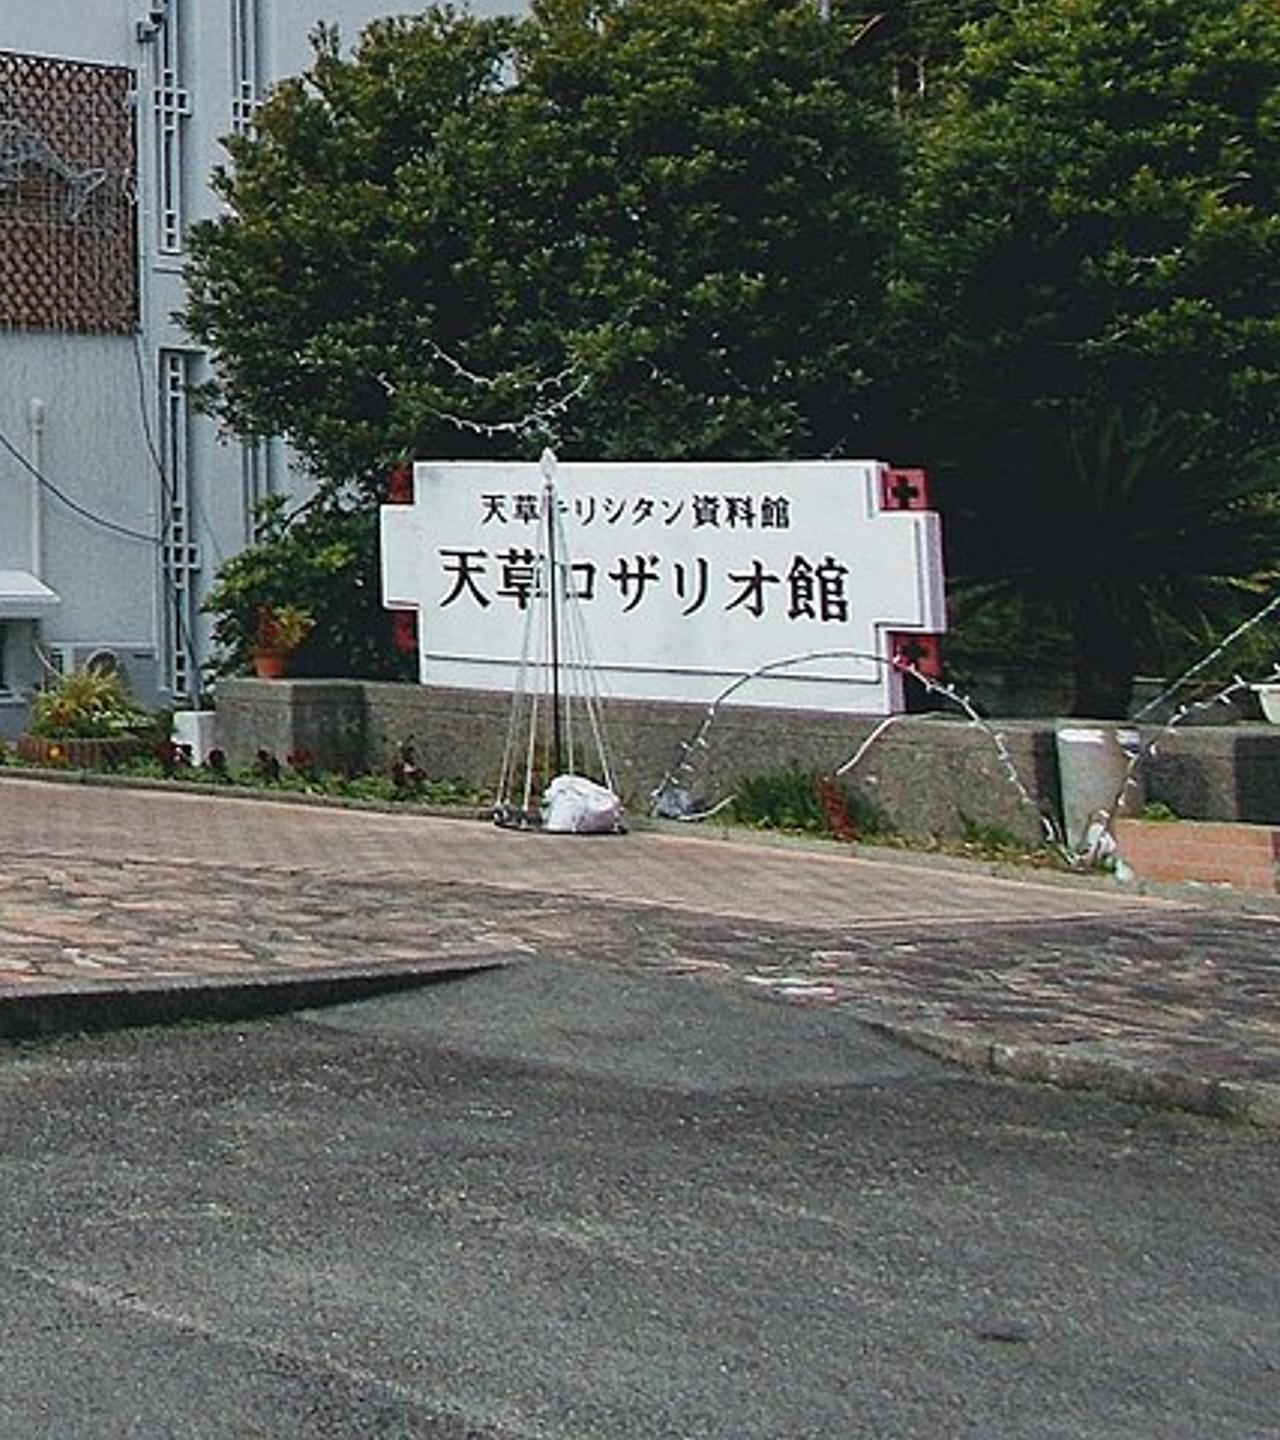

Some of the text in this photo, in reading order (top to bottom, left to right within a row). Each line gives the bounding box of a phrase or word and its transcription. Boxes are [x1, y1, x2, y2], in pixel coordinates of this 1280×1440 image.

[439, 548, 849, 621] 天草ロザリオ館
